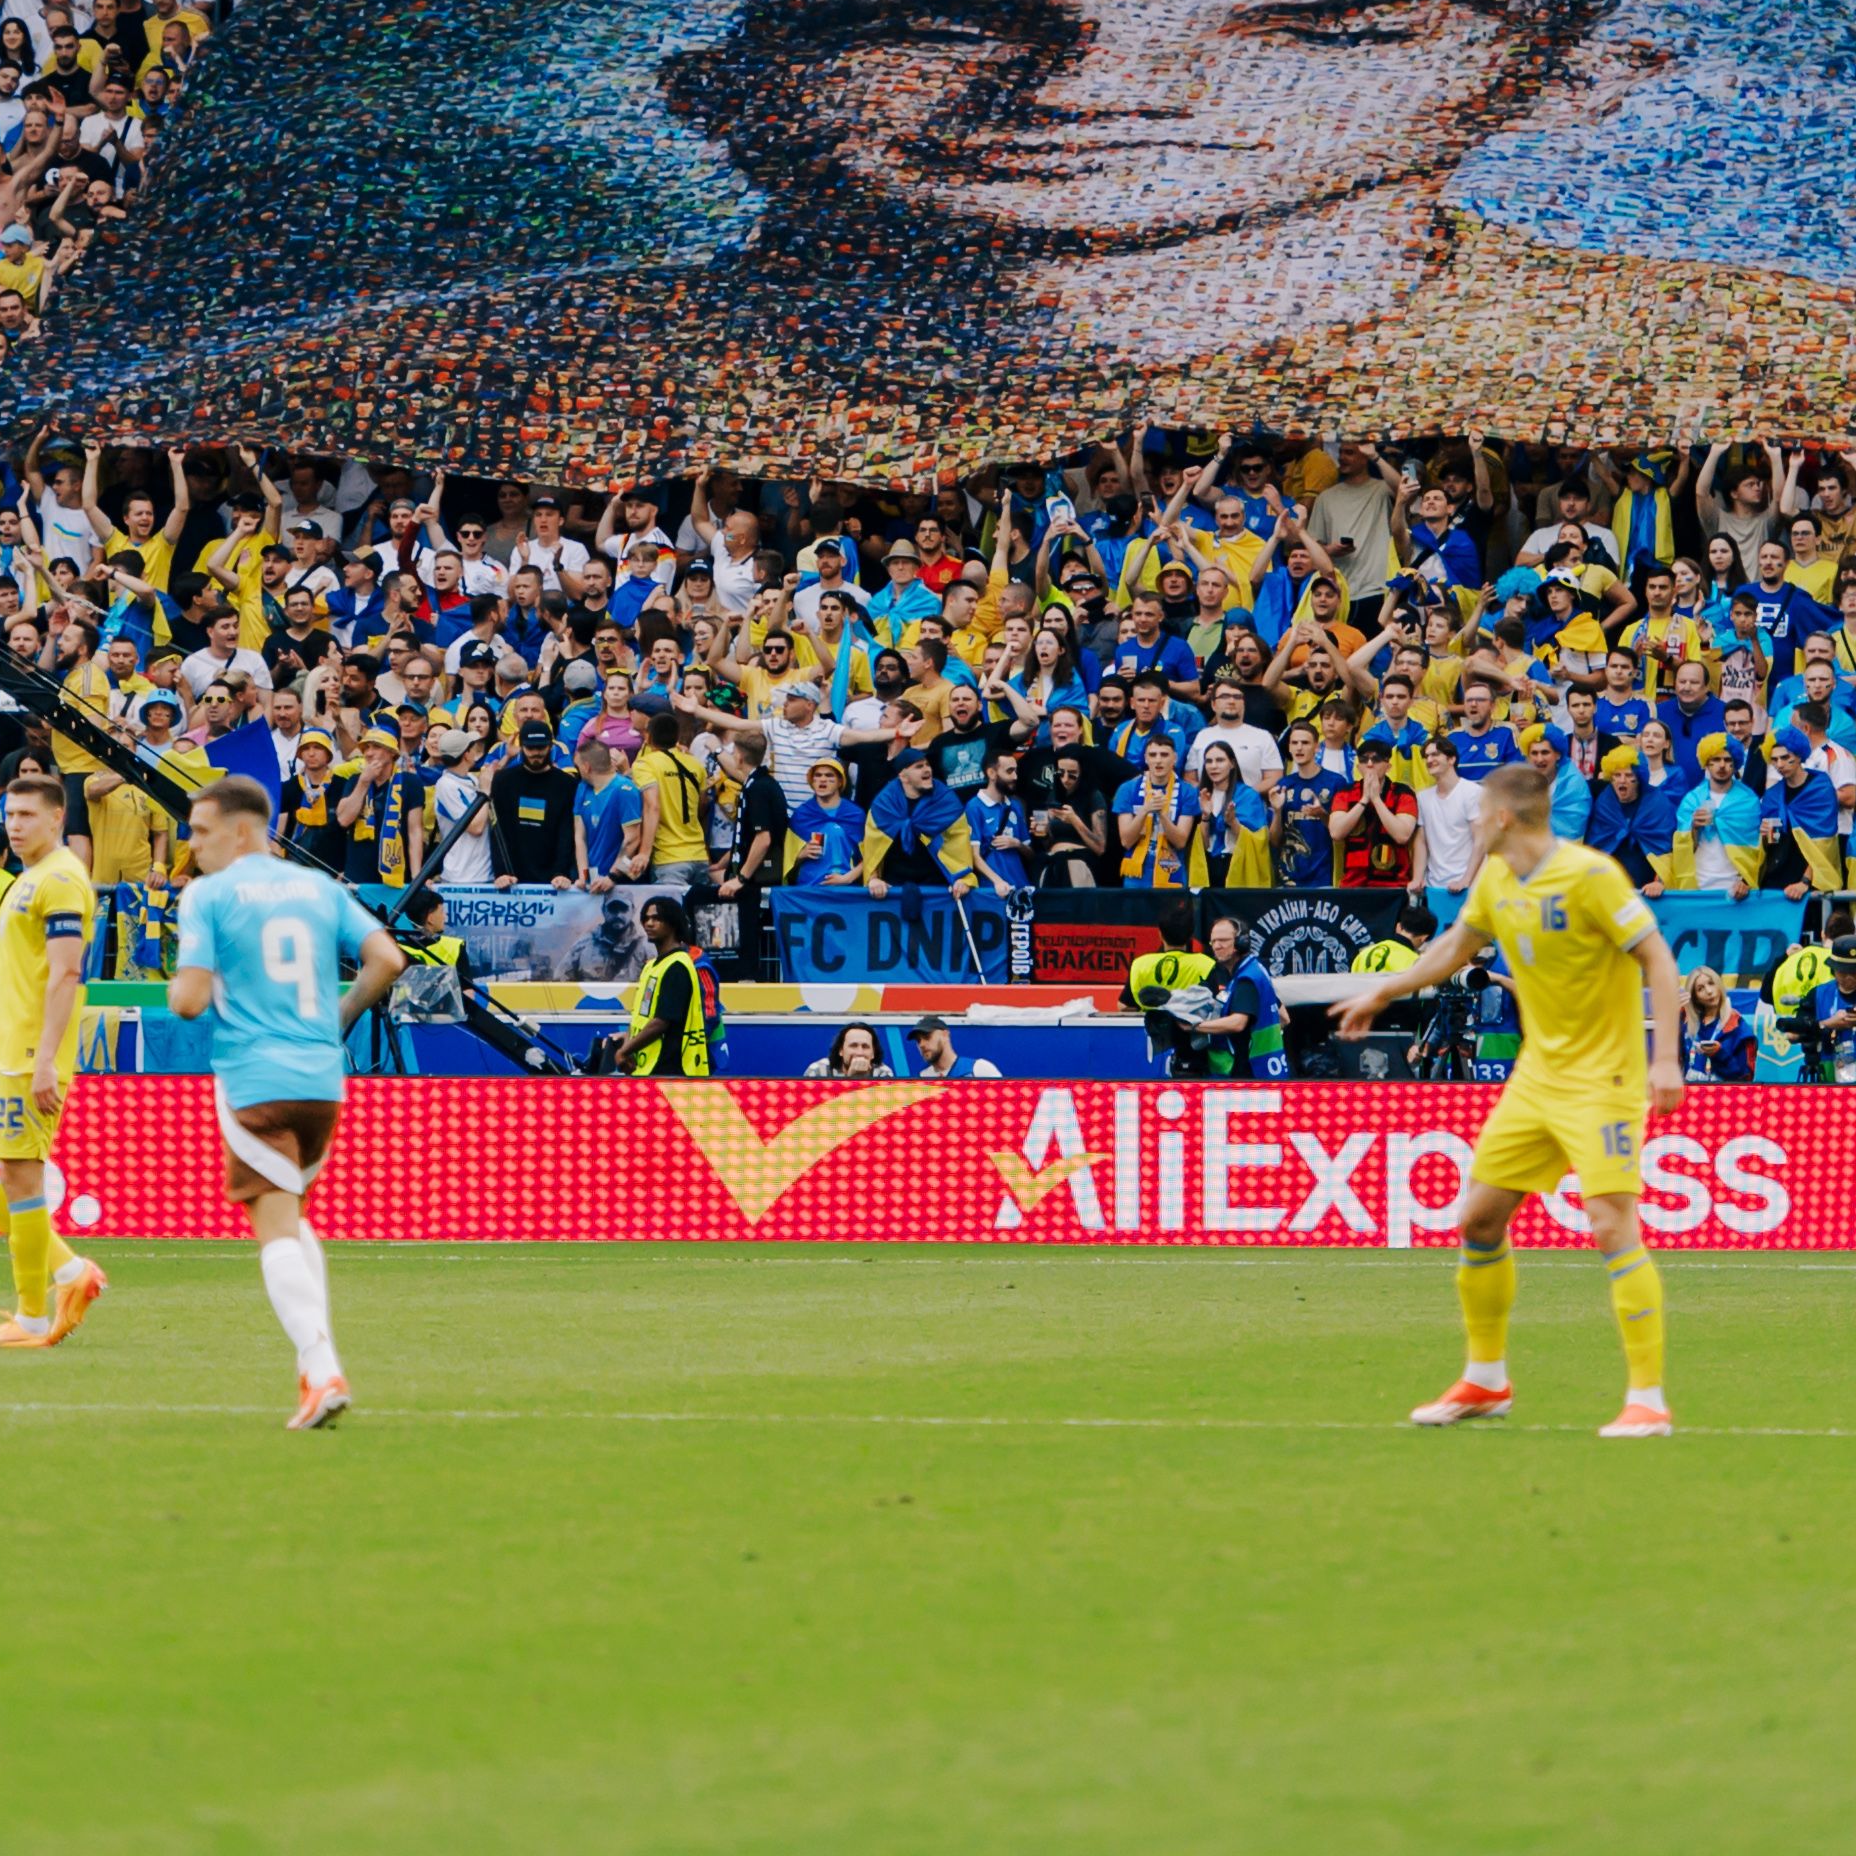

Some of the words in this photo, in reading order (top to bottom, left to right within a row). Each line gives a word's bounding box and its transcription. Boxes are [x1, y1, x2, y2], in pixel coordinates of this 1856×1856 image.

[779, 912, 846, 973] FC
[1541, 895, 1568, 932] 16
[261, 917, 322, 1020] 9
[992, 1088, 1790, 1249] AliExpss
[1600, 1121, 1633, 1158] 16
